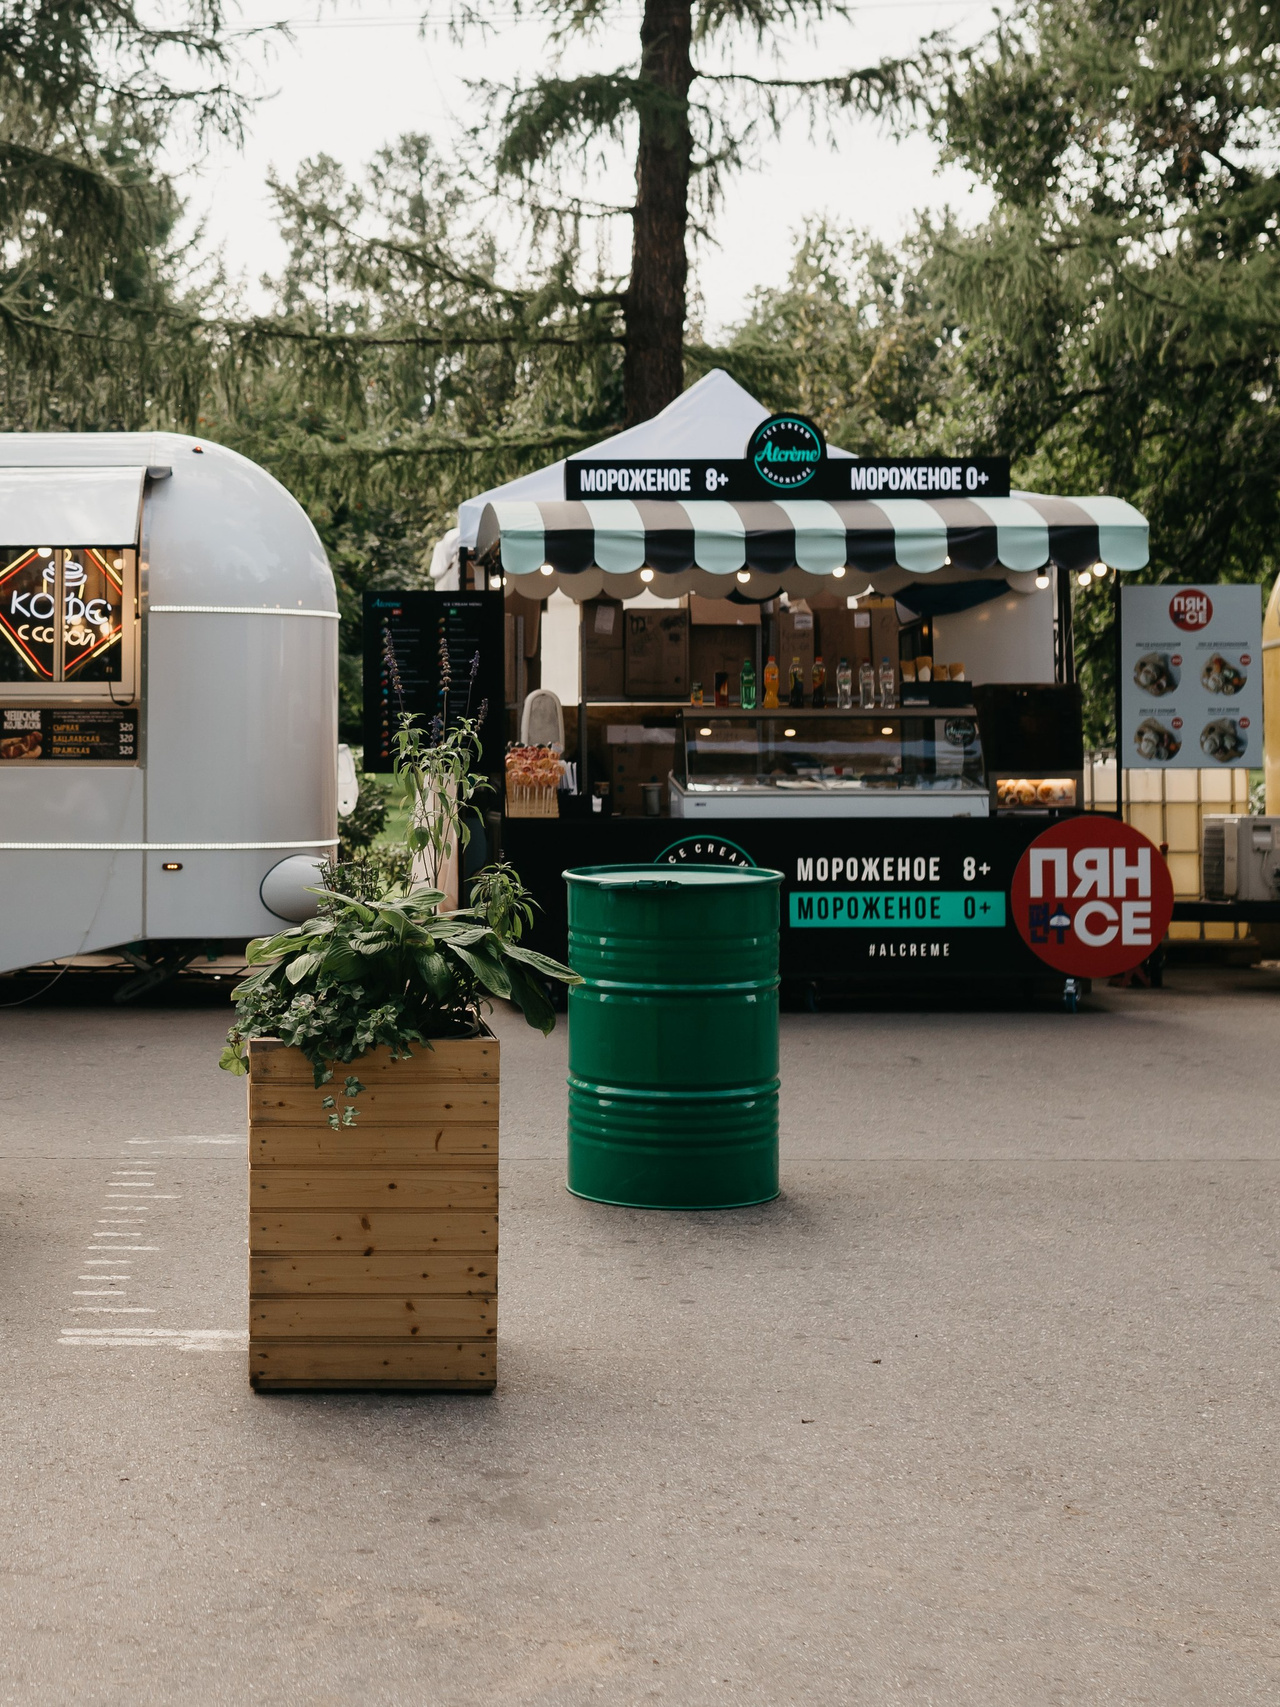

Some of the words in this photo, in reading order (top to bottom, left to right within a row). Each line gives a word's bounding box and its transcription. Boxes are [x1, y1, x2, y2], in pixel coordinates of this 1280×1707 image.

[580, 468, 691, 491] МОРОЖЕНОЕ
[705, 468, 730, 491] 8+
[851, 466, 963, 491] МОРОЖЕНОЕ
[1173, 596, 1207, 612] ПЯН
[119, 723, 134, 732] 320
[119, 734, 134, 743] 320
[119, 746, 134, 755] 320
[668, 848, 687, 864] CE
[797, 856, 941, 882] МОРОЖЕНОЕ
[962, 856, 991, 882] 8+
[1029, 847, 1152, 899] ПЯН
[798, 896, 941, 920] МОРОЖЕНОЕ
[1073, 899, 1152, 947] СЕ
[869, 942, 950, 958] #ALCREME
